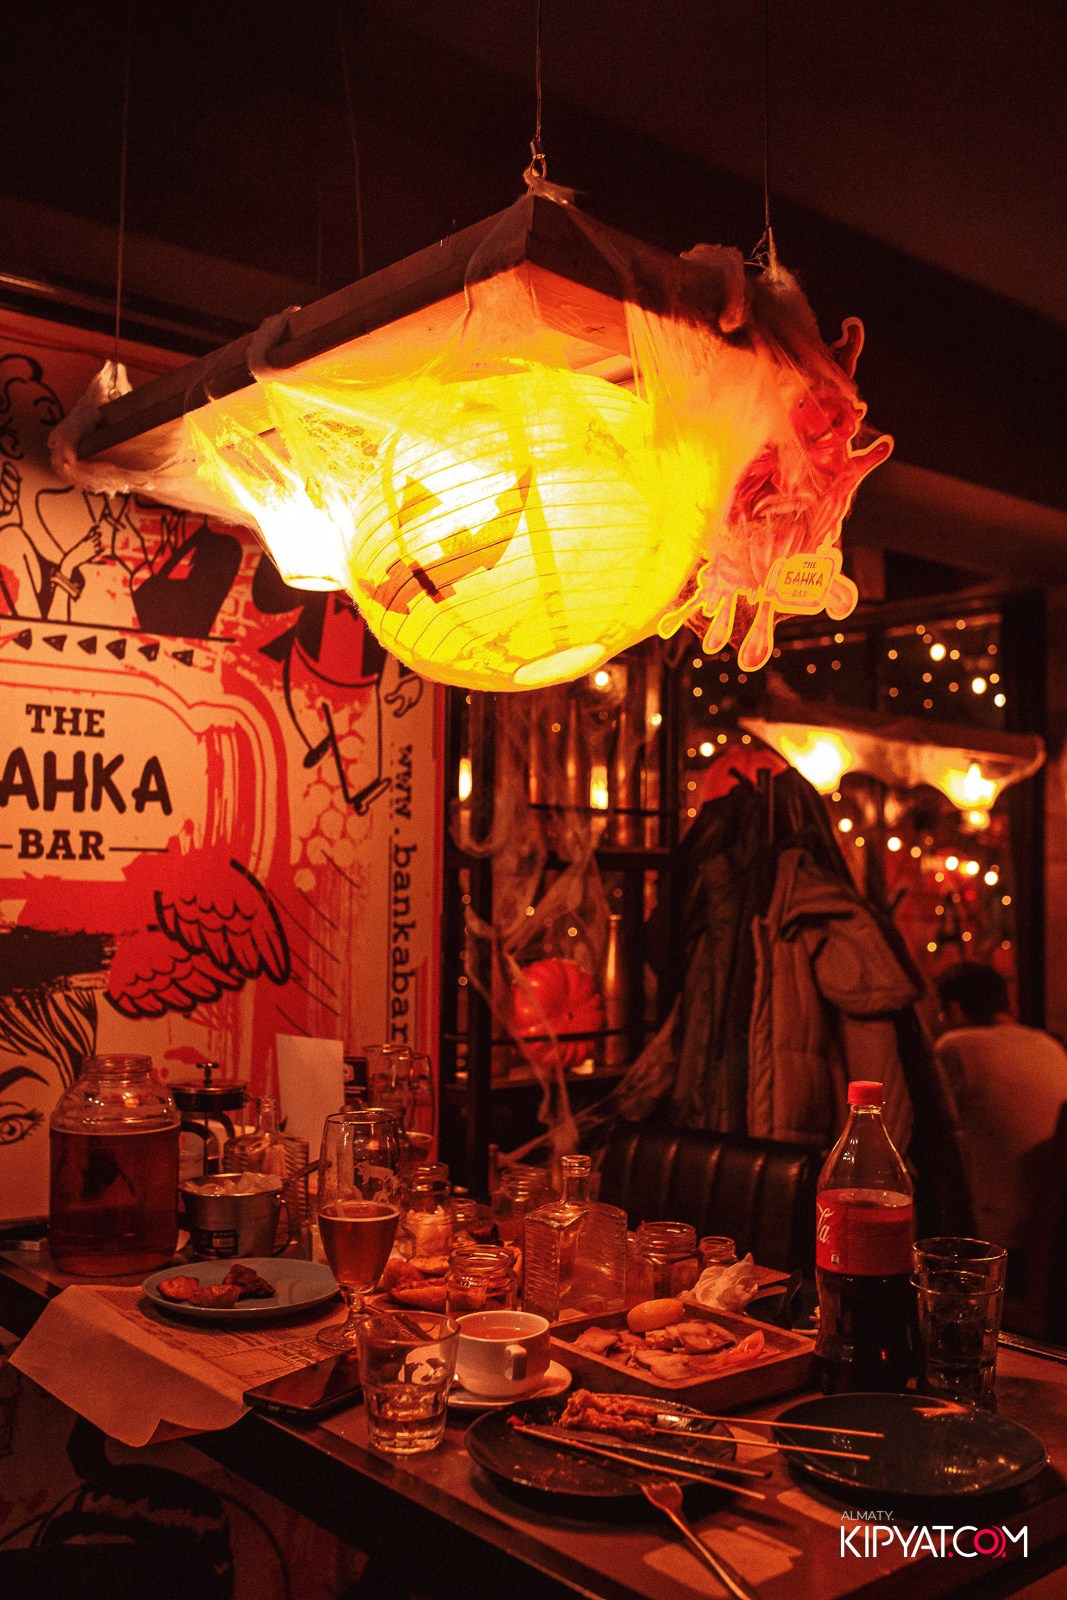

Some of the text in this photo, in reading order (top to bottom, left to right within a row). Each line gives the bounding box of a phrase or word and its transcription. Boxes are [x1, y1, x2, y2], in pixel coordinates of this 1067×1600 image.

[803, 561, 818, 569] THE
[784, 570, 824, 586] БАНКА
[25, 703, 105, 738] THE
[18, 828, 106, 860] BAR
